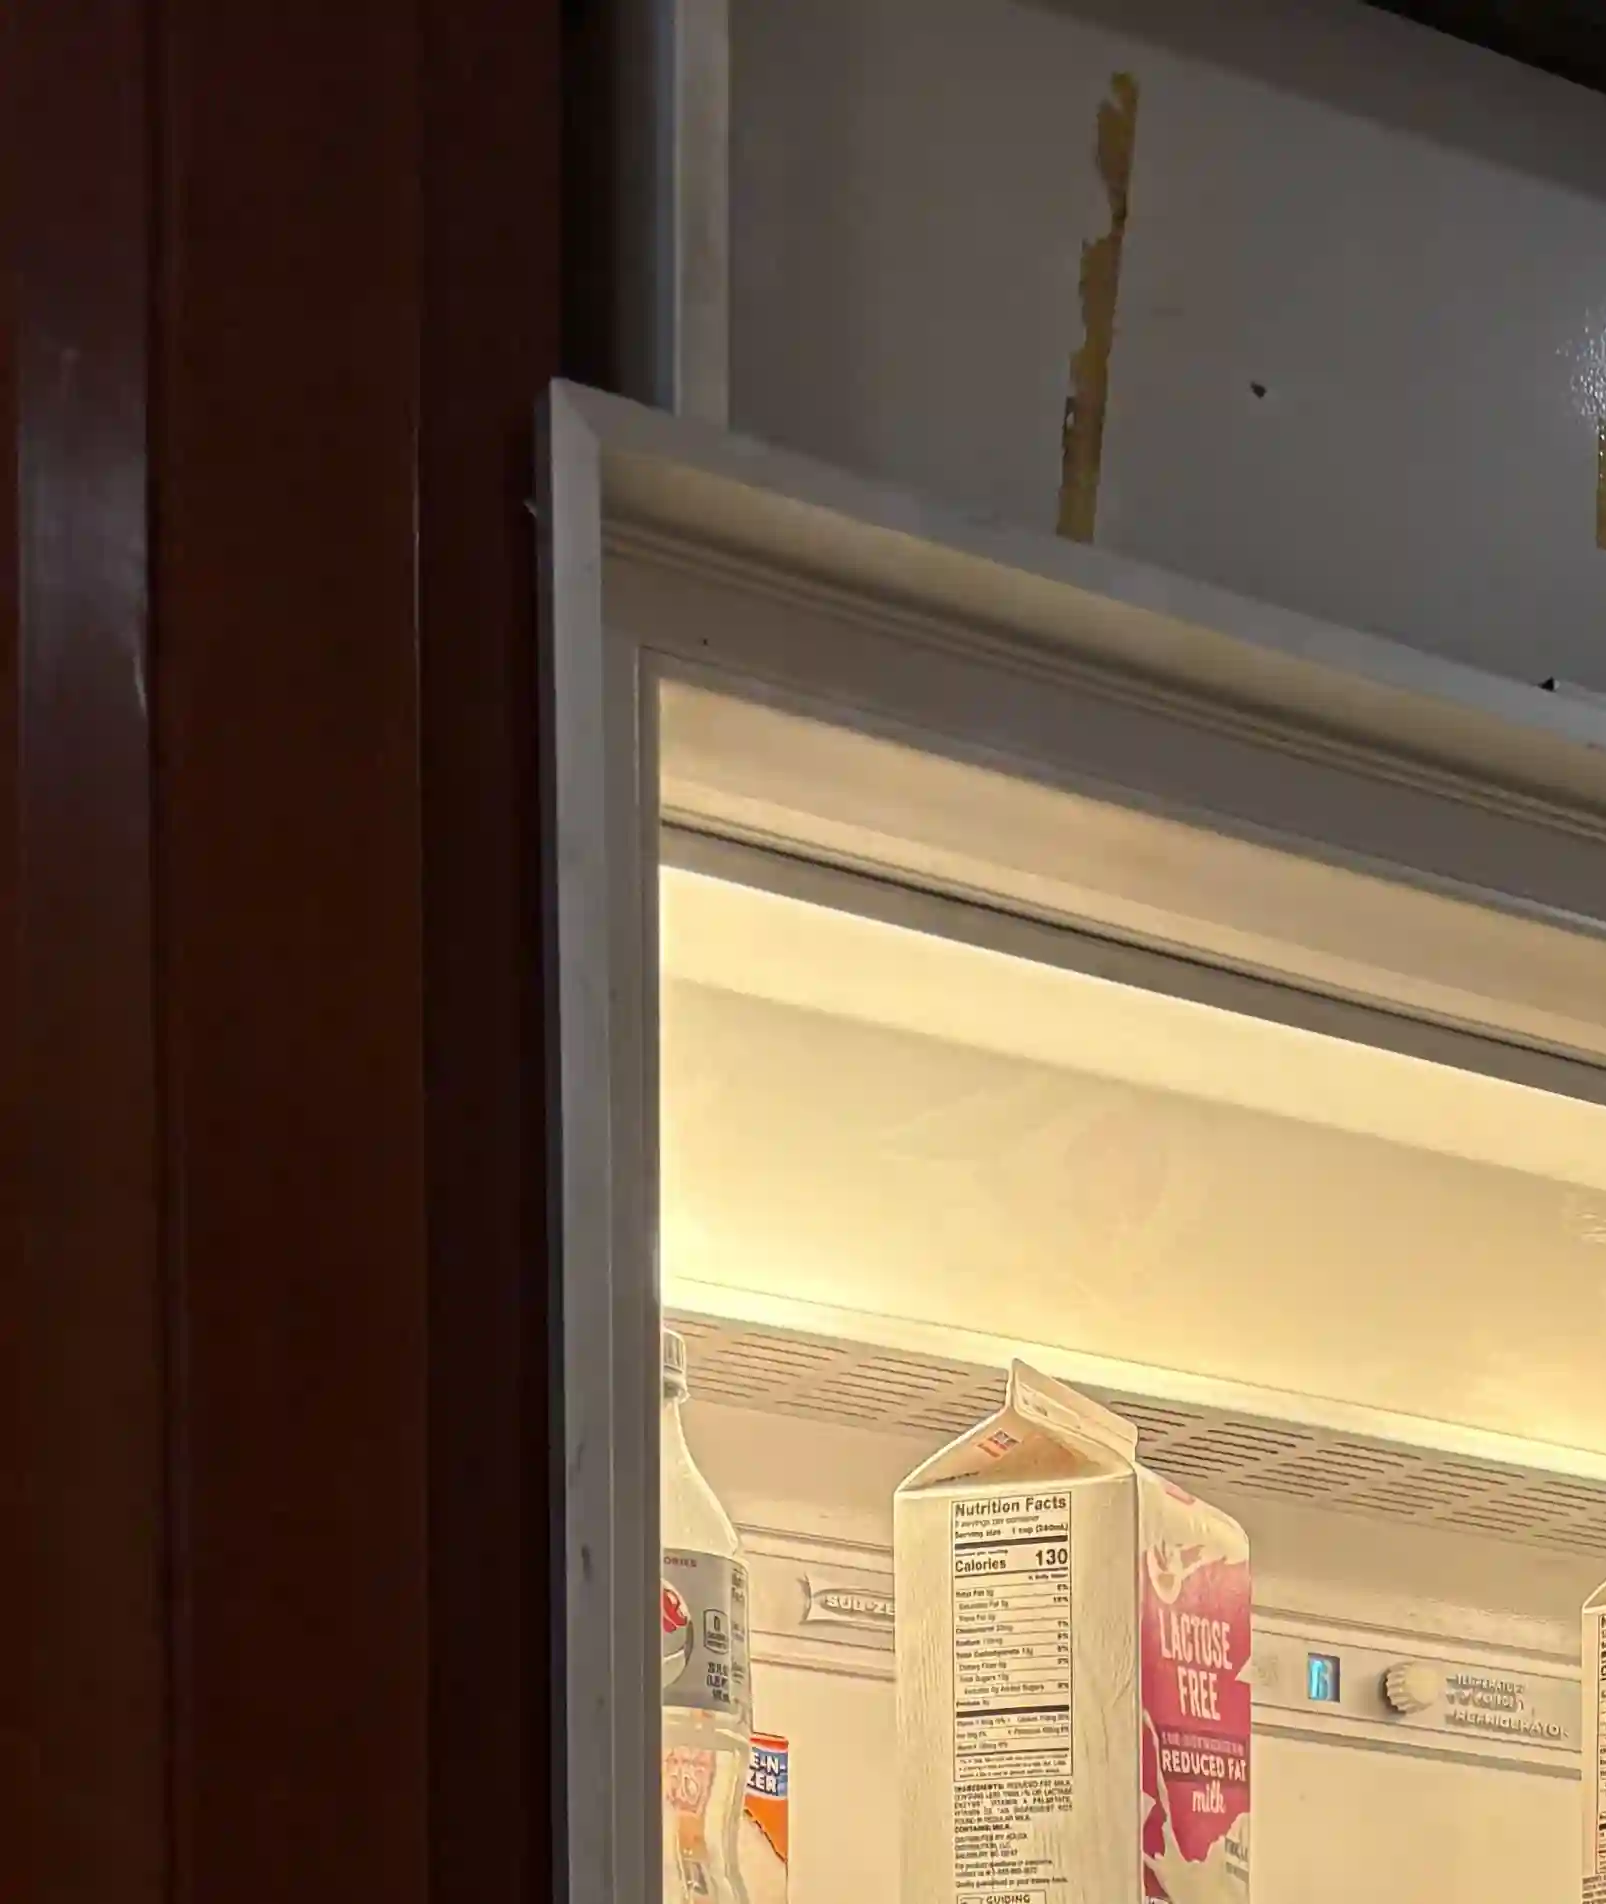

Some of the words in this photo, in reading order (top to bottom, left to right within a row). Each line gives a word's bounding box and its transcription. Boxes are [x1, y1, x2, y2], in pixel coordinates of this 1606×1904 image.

[955, 1500, 1020, 1517] Nutrition
[1026, 1496, 1067, 1512] Facts
[955, 1558, 1007, 1572] Calories
[1035, 1548, 1068, 1566] 130
[1158, 1608, 1233, 1670] LACTOSE
[1178, 1666, 1221, 1721] FREE
[1162, 1749, 1225, 1777] REDUCED
[1227, 1757, 1247, 1782] FAT
[1191, 1780, 1226, 1814] milk
[986, 1894, 1030, 1904] GUIDING
